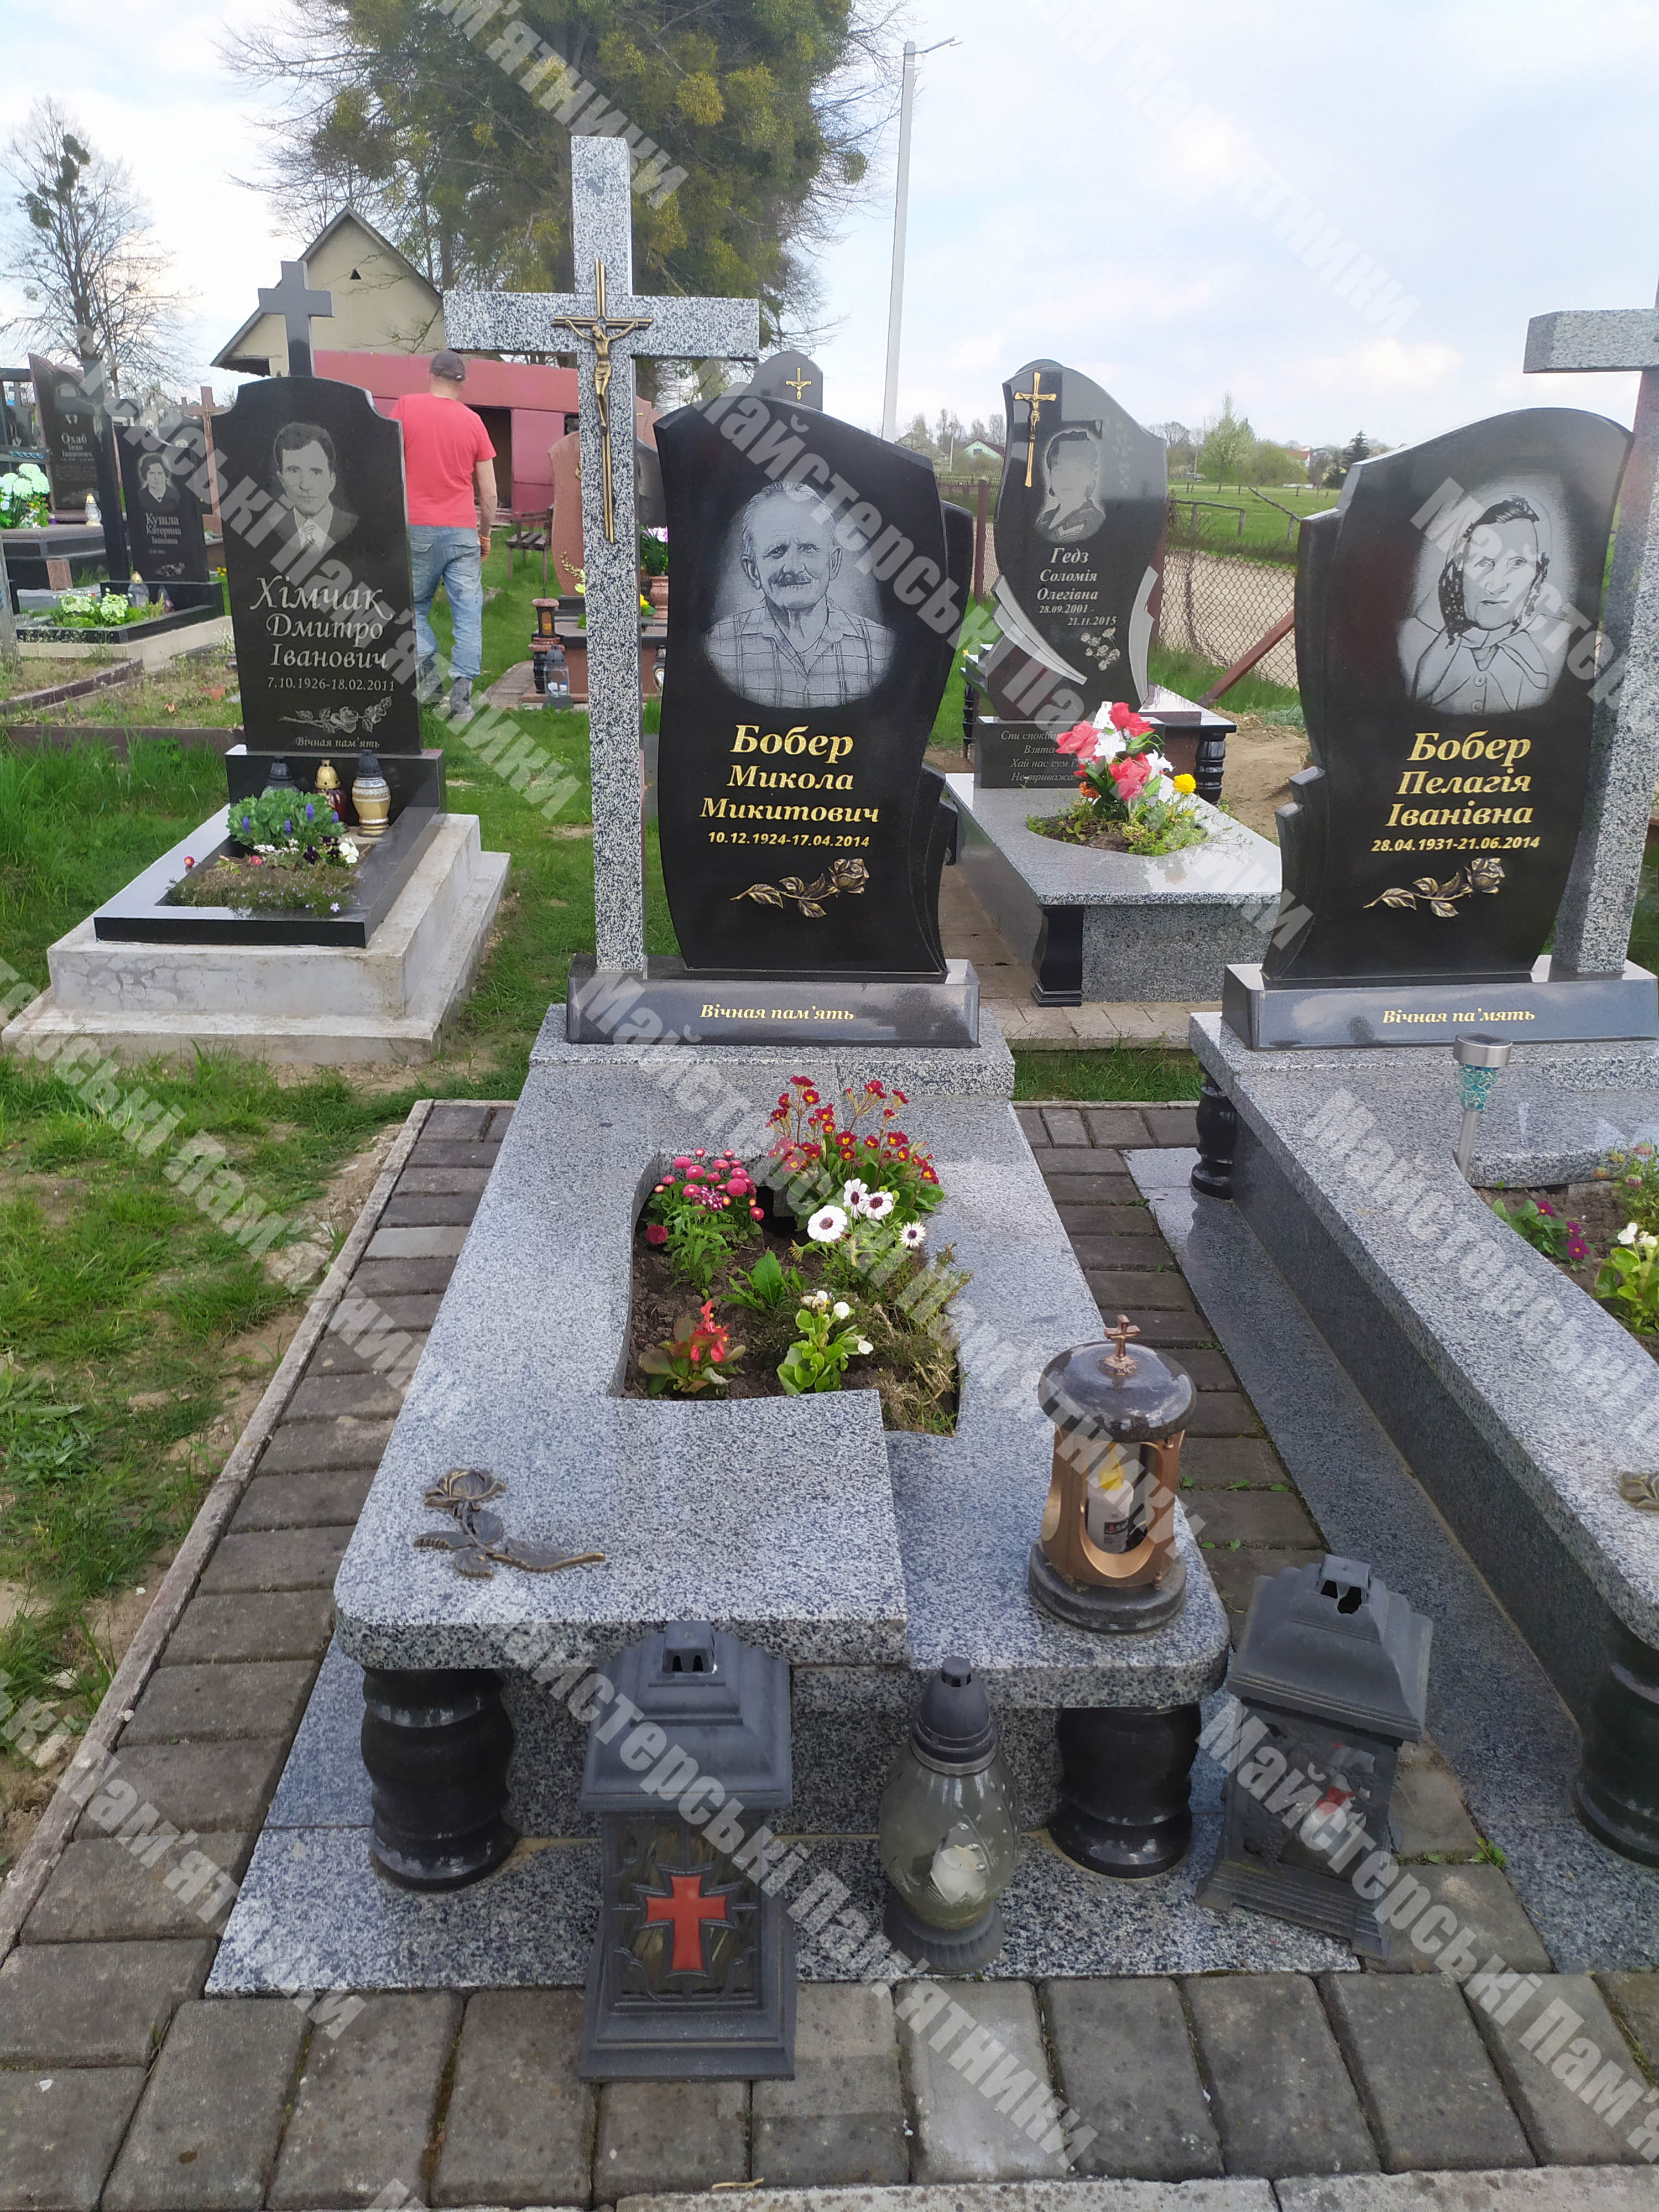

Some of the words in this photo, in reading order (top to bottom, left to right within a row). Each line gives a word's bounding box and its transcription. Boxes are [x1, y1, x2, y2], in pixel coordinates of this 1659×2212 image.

[1050, 546, 1089, 564] Гедз
[1039, 569, 1097, 582] Соломія
[249, 576, 394, 620] Хімчак
[1036, 587, 1099, 601] Олегівна
[1039, 604, 1088, 614] 28.09.2001
[1067, 616, 1117, 626] 21.11.2015
[266, 613, 384, 648] Дмитро
[270, 643, 388, 669] Іванович
[268, 676, 395, 691] 7.10.1926-18.02.2011
[729, 724, 854, 764] Бобер
[1406, 730, 1532, 767] Бобер
[726, 765, 854, 790] Микола
[1395, 768, 1531, 795] Пелагія
[699, 797, 880, 823] Микитович
[1384, 801, 1534, 827] Іванівна
[708, 831, 871, 848] 10.12.1924-17.04.2014
[1370, 836, 1541, 852] 28.04.1931-21.06.2014
[700, 1004, 765, 1020] Вічная
[771, 1004, 854, 1021] пам'ять
[1382, 1009, 1447, 1024] Вічная
